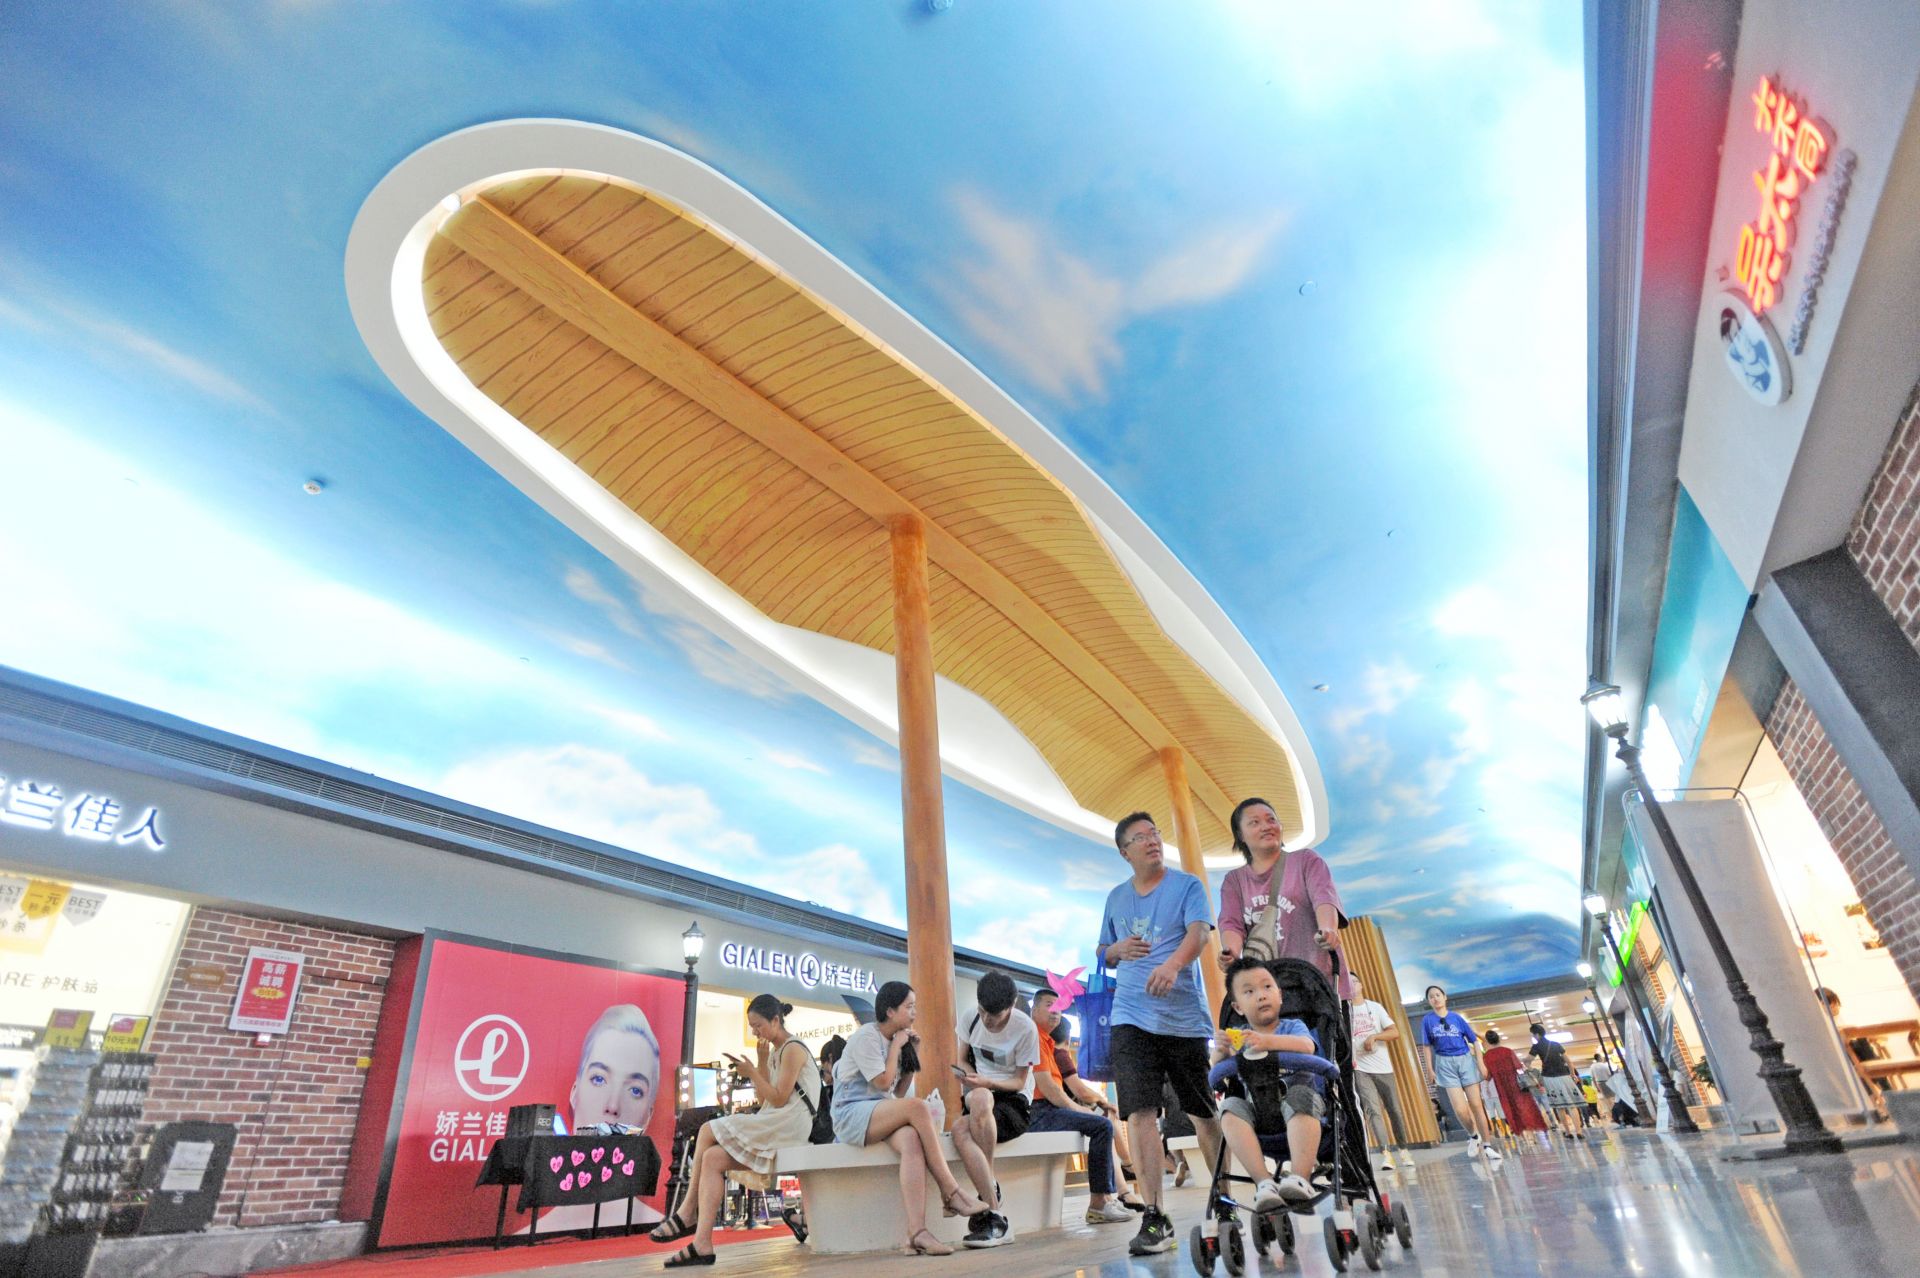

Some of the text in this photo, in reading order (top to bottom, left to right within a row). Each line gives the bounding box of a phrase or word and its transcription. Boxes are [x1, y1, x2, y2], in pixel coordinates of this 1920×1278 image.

[0, 777, 166, 850] 兰佳人
[1251, 894, 1296, 914] FREDOM
[0, 970, 34, 987] RE
[721, 941, 796, 978] GIALEN
[822, 961, 879, 993] 娇兰佳人
[434, 1110, 507, 1136] 娇兰佳
